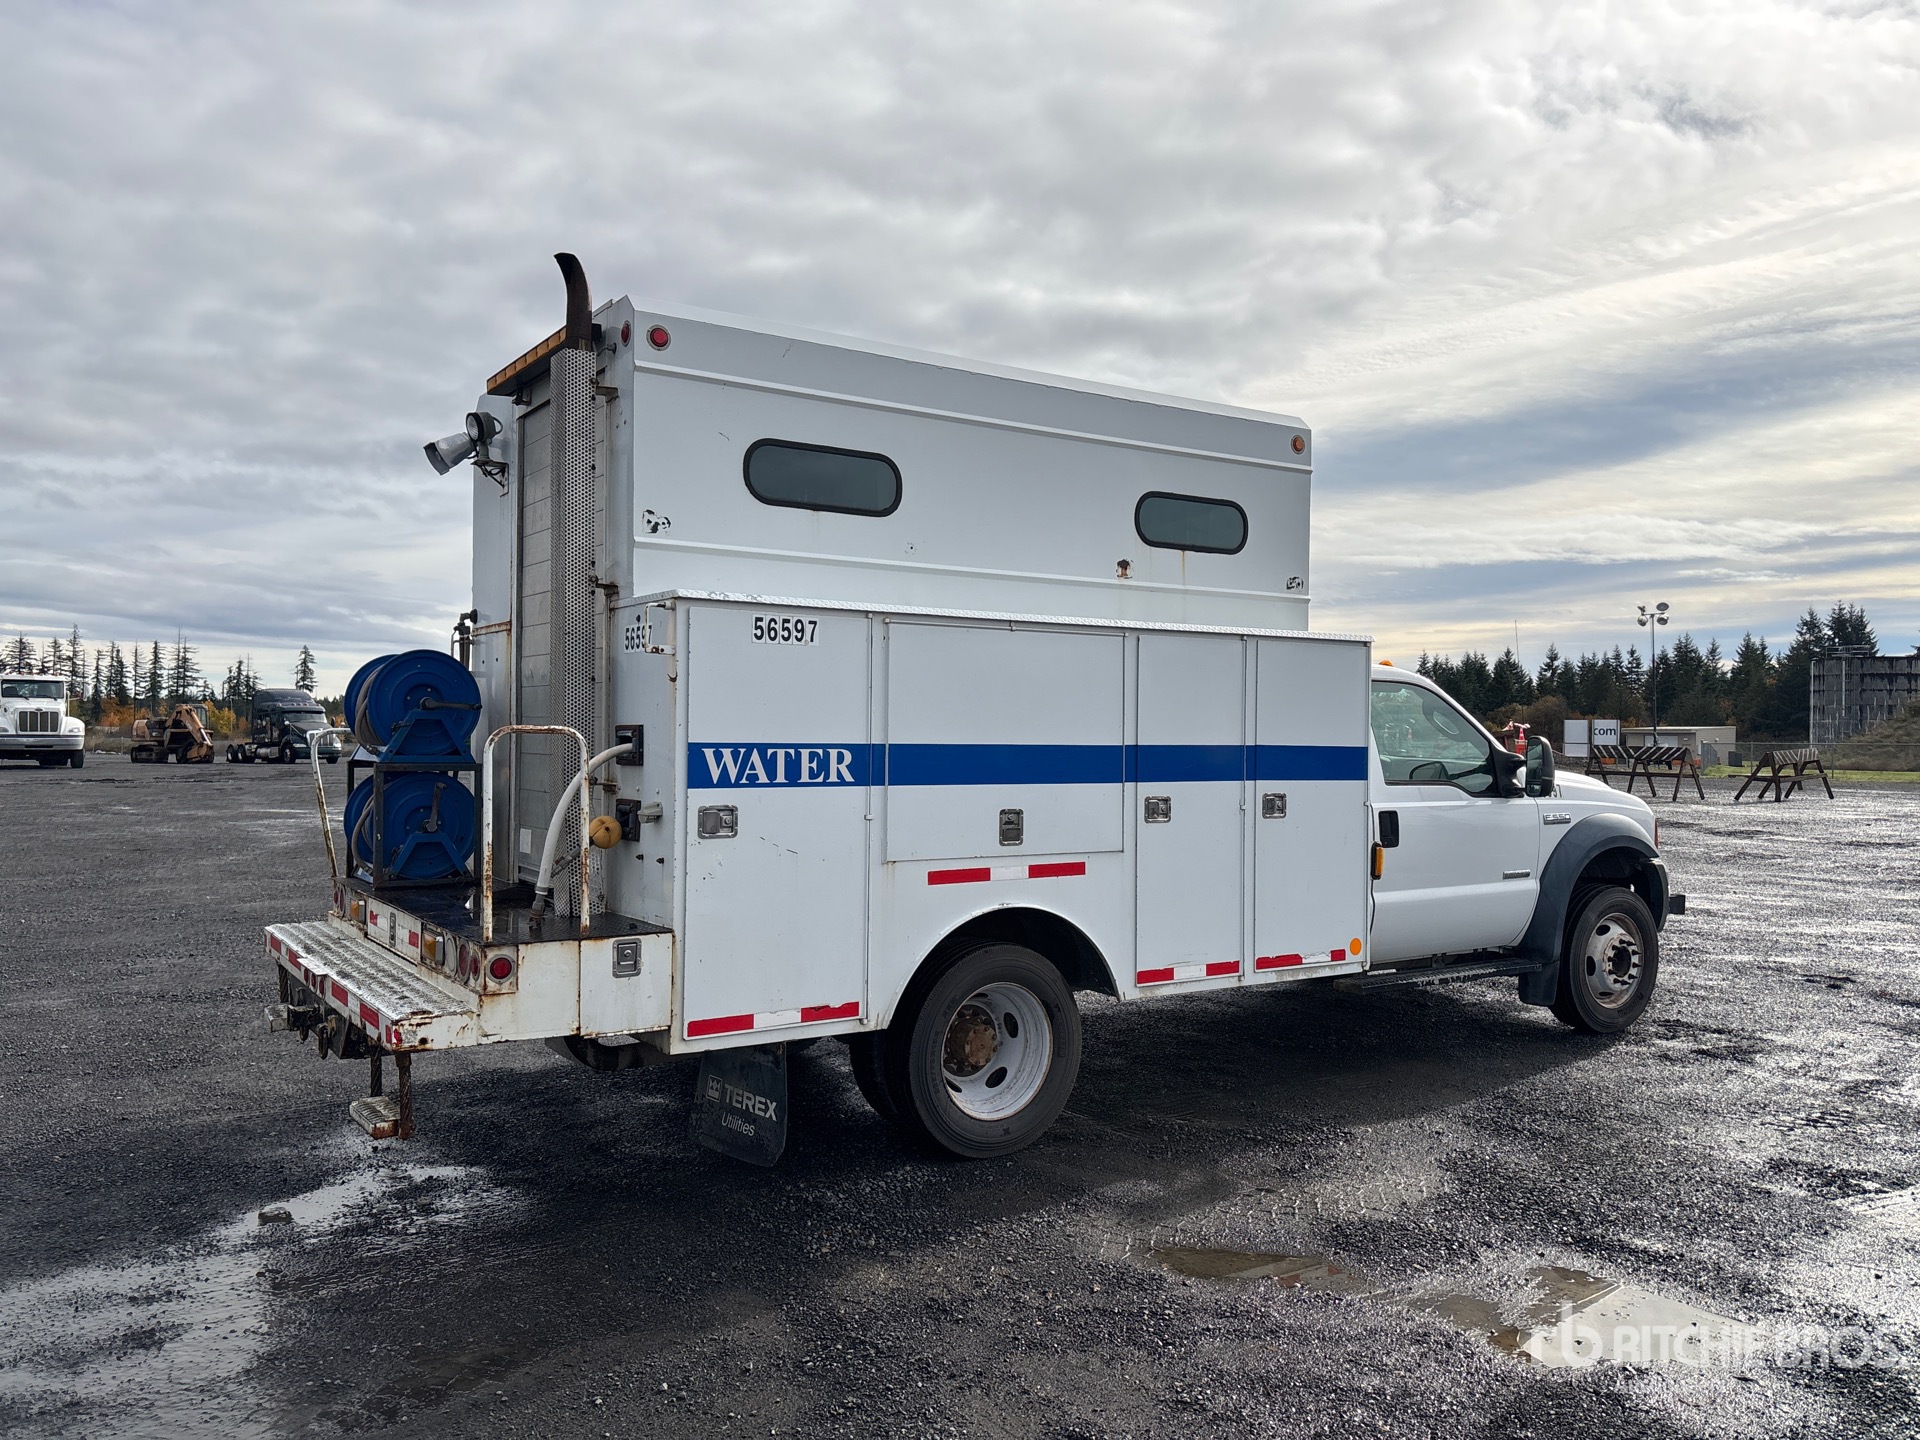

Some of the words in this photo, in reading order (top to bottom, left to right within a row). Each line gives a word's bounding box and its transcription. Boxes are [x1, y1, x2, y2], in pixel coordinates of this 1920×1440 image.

[753, 616, 818, 643] 56597
[700, 747, 855, 785] WATER
[724, 1083, 777, 1122] TEREX
[721, 1111, 755, 1136] Utilities
